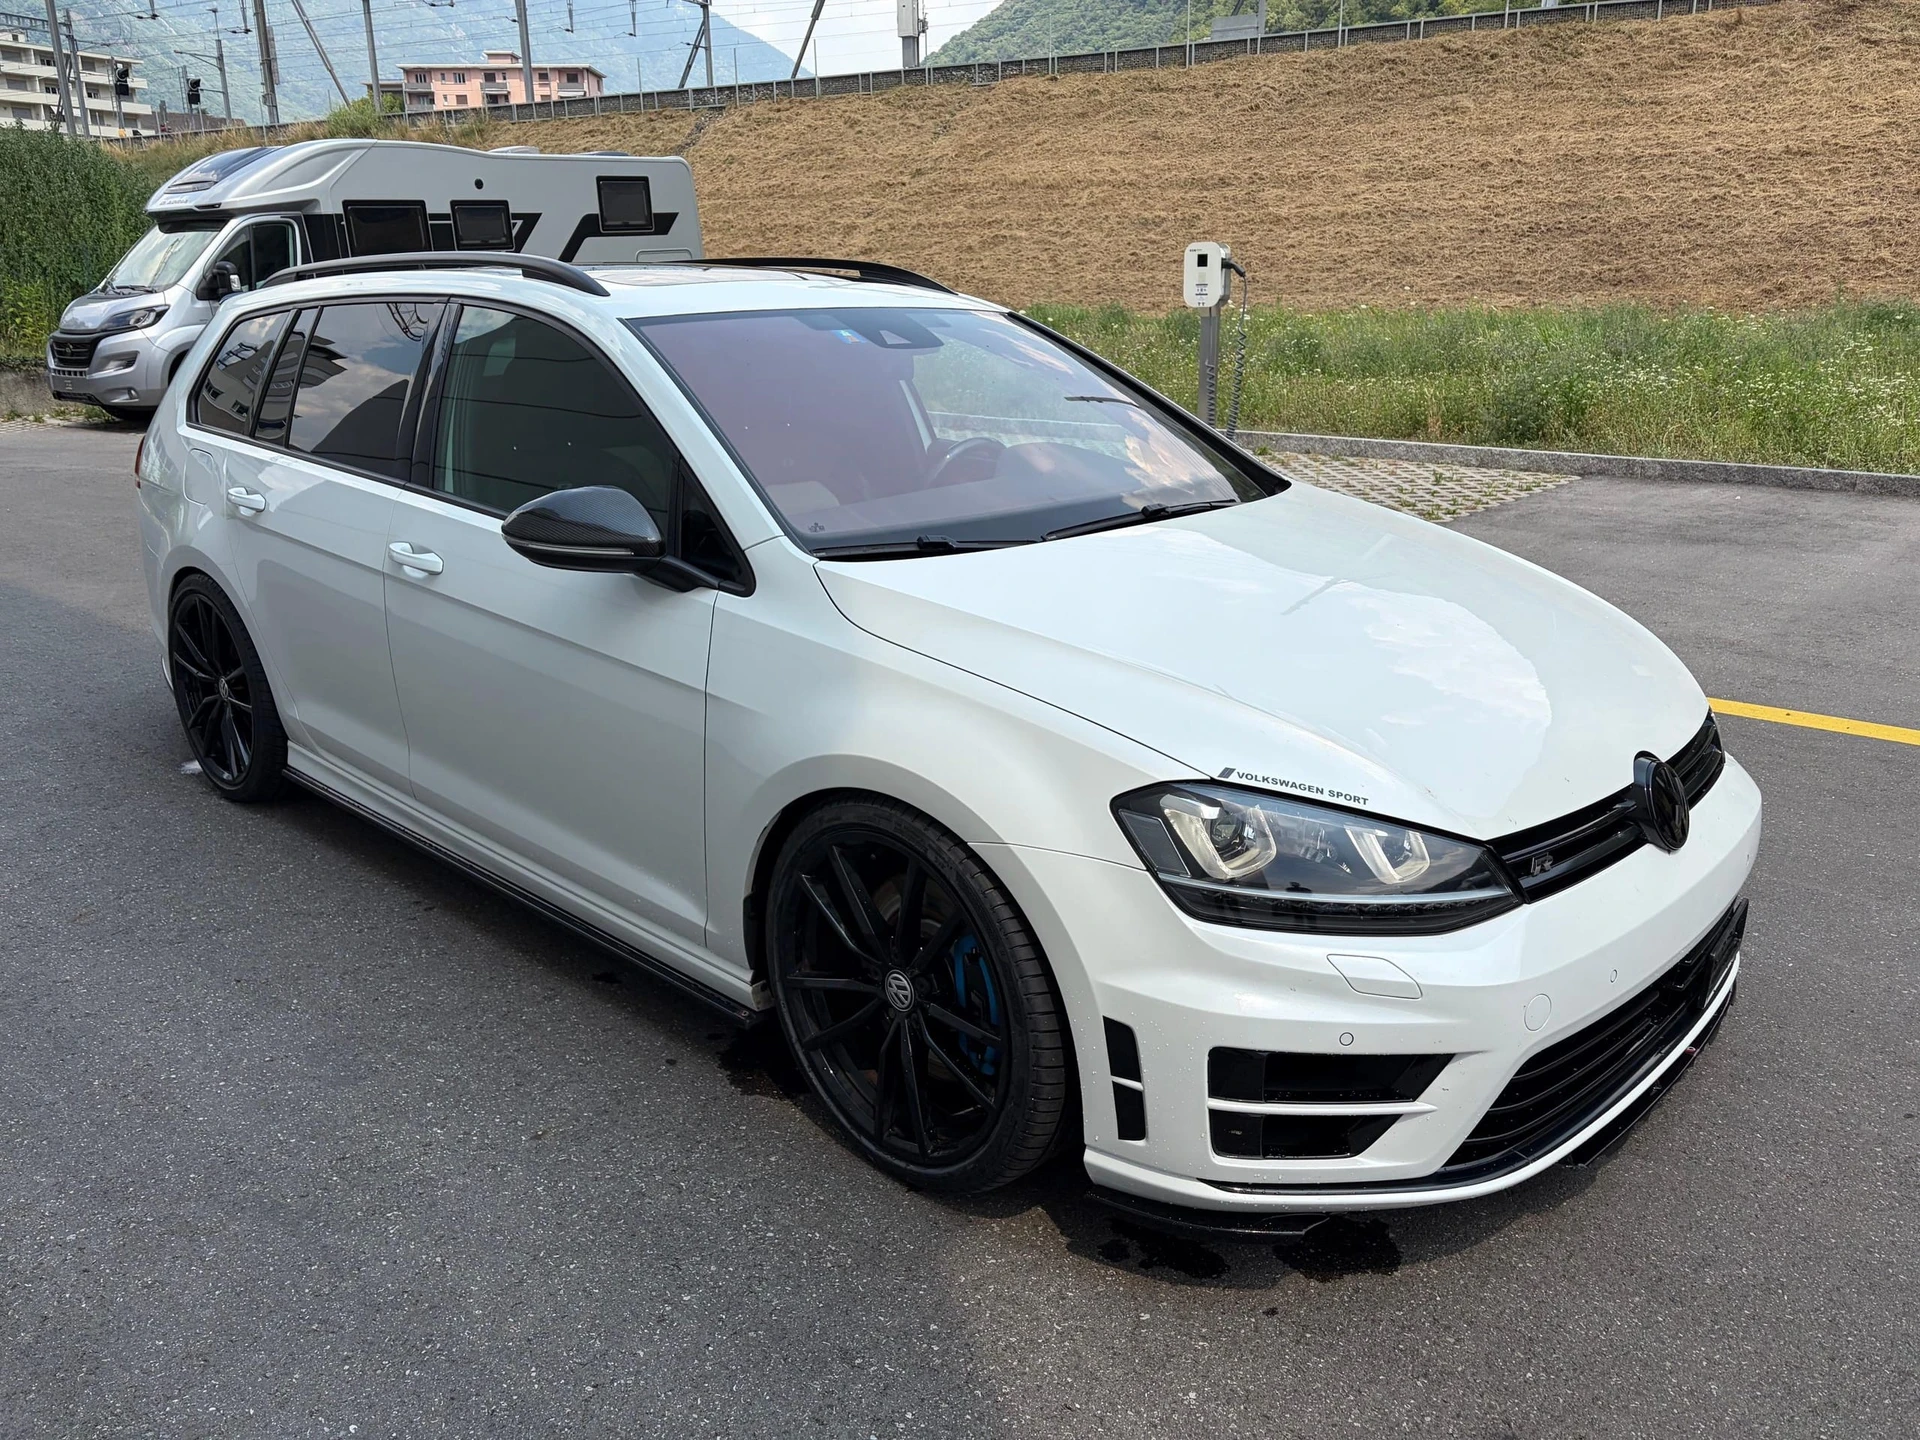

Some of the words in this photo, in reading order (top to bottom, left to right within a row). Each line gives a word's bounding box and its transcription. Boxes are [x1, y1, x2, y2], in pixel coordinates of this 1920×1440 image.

[1237, 771, 1324, 795] VOLKSWAGEN
[1328, 790, 1369, 806] SPORT
[1531, 852, 1554, 876] R
